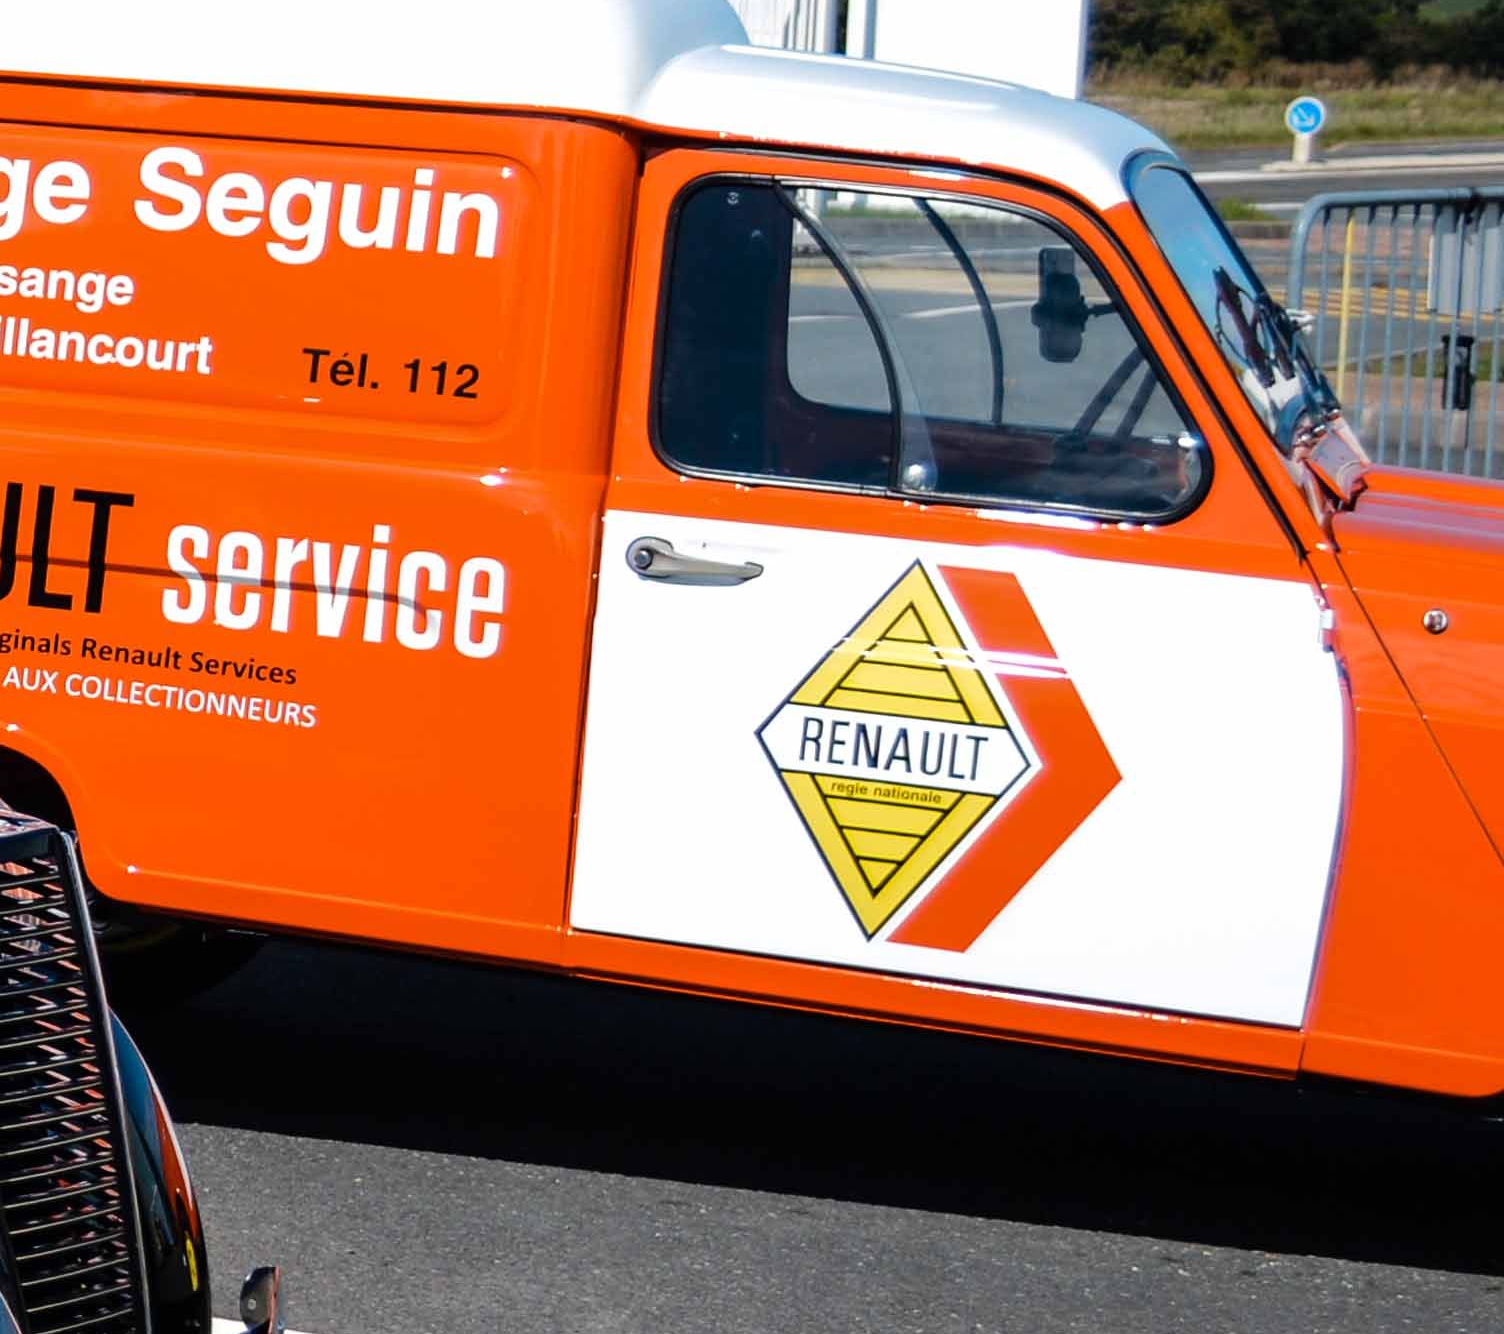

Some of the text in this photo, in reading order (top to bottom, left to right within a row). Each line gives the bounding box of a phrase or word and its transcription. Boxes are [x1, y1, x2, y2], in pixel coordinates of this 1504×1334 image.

[134, 146, 500, 265] Seguin
[403, 358, 480, 399] 112
[162, 524, 505, 659] service
[81, 638, 181, 671] Renault
[190, 651, 297, 685] Services
[3, 666, 60, 694] AUX
[65, 674, 316, 728] COLLECTIONNEURS
[799, 717, 988, 781] RENAULT
[874, 786, 942, 804] nationale
